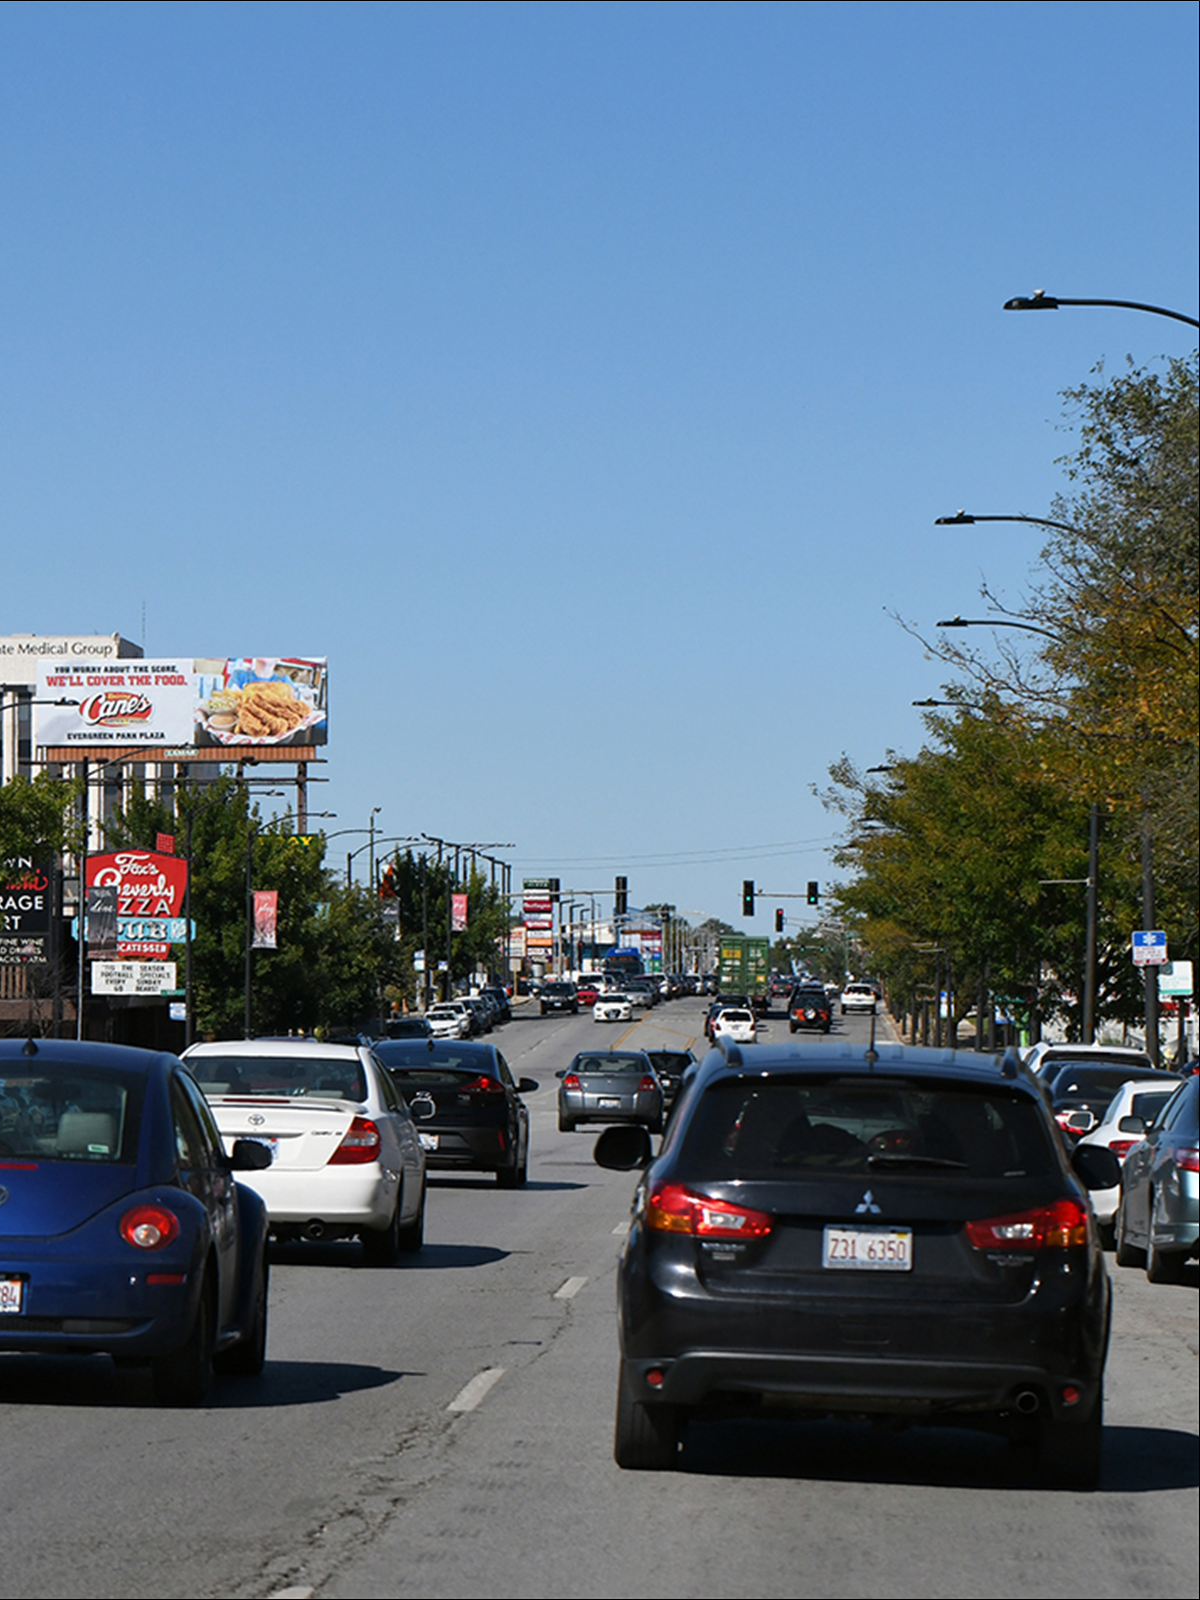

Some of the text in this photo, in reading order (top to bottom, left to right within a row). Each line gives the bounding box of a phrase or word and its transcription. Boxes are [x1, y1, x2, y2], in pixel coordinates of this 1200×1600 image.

[18, 643, 68, 655] Medical
[71, 643, 113, 657] Group
[152, 666, 179, 674] SCORE,
[46, 675, 188, 687] WE'LL COVER THE FOOD.
[82, 692, 152, 726] Cane's
[114, 853, 159, 875] Fox's
[830, 1238, 906, 1261] Z31 6350
